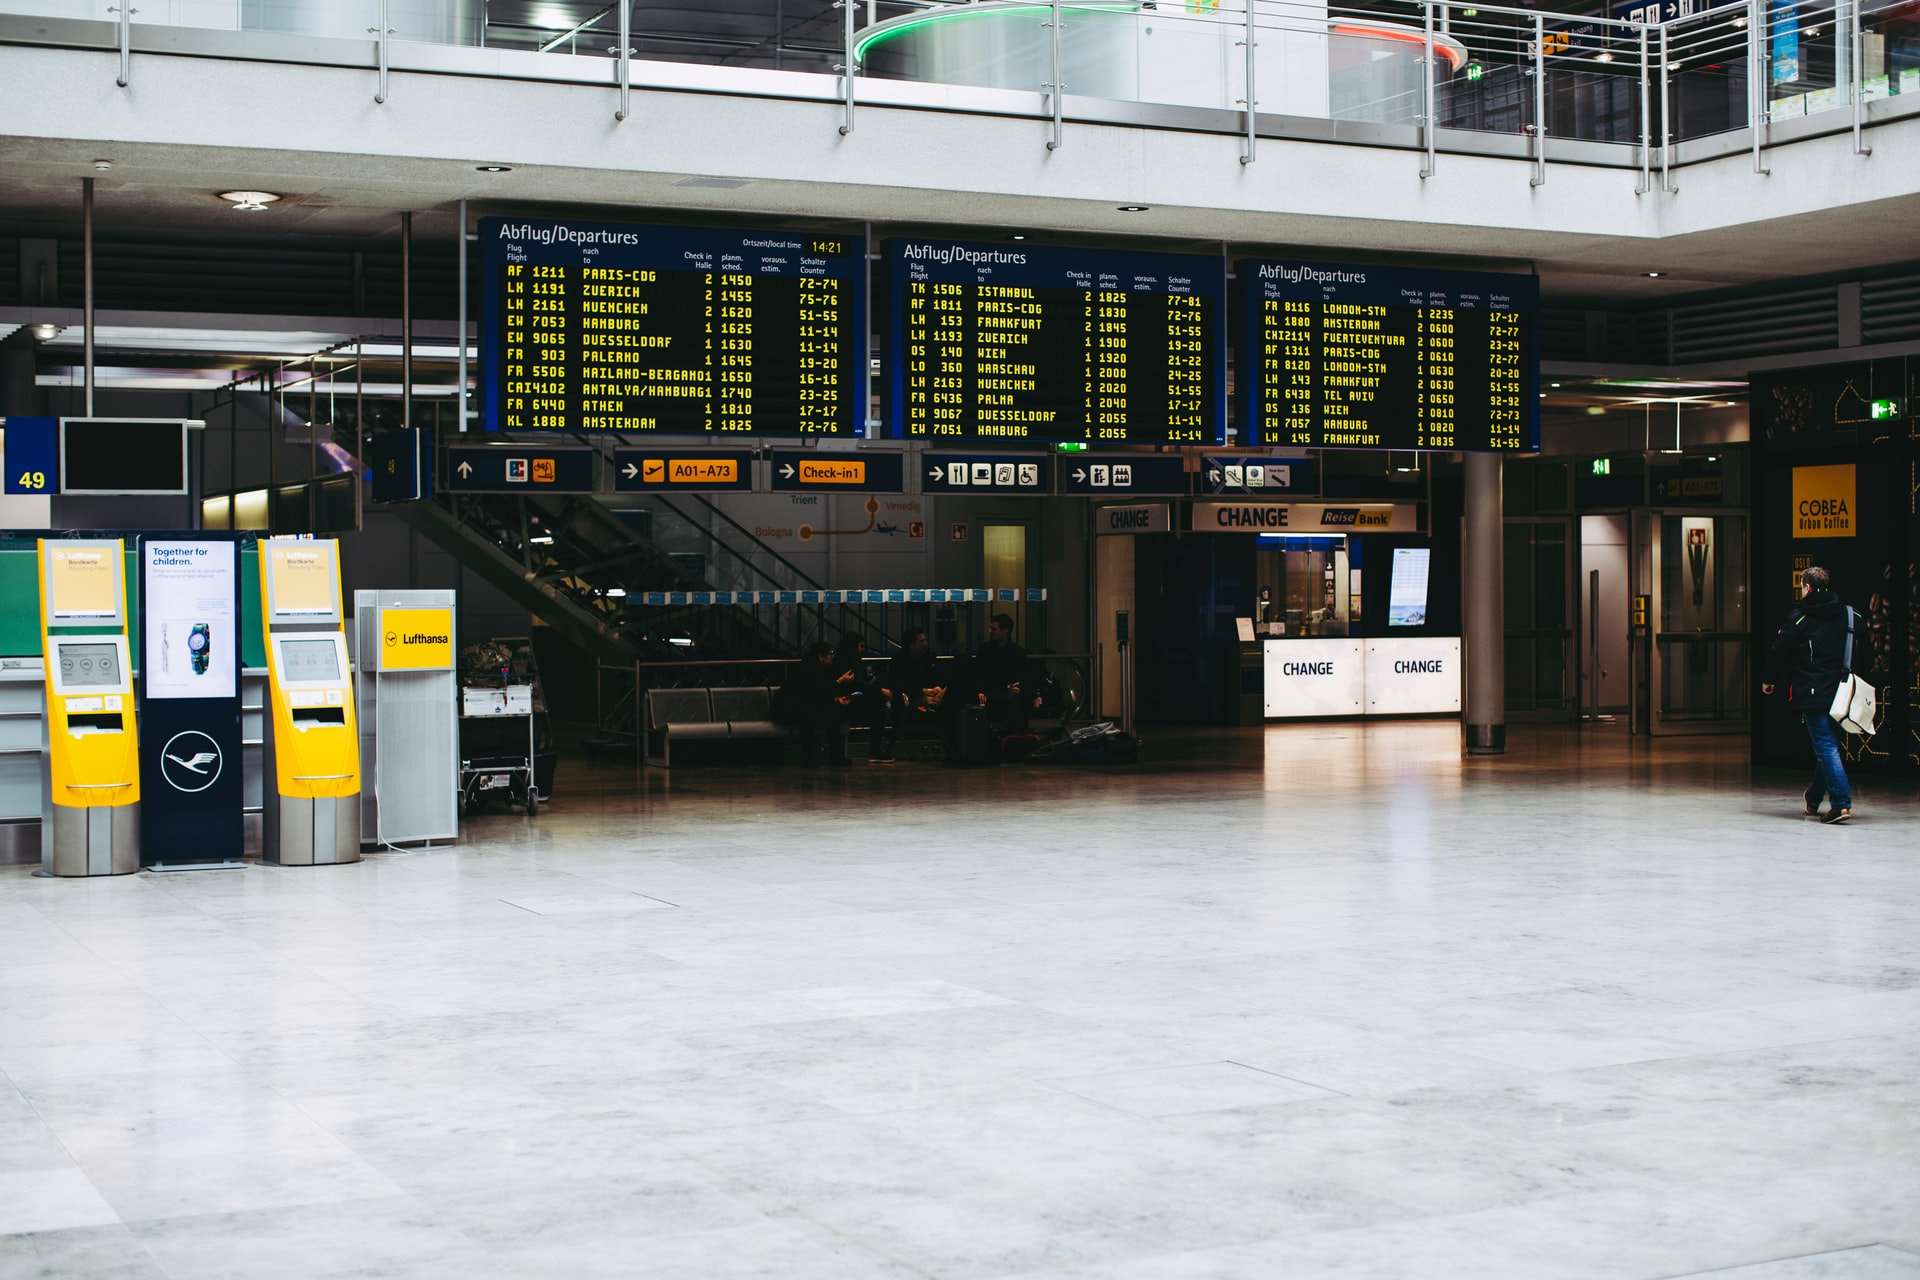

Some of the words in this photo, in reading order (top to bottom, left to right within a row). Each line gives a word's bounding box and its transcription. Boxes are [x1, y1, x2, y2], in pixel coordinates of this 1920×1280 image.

[500, 224, 638, 246] Abflug/Departures
[507, 244, 522, 252] Flug
[743, 239, 786, 248] Ortszeit/local
[787, 240, 802, 248] time
[812, 241, 841, 253] 14:21
[507, 253, 527, 262] Flight
[684, 252, 704, 260] Check
[722, 254, 744, 262] planm.
[800, 258, 826, 266] Schalter
[904, 244, 1026, 266] Abflug/Departures
[696, 262, 712, 270] Halle
[800, 266, 825, 274] Counter
[507, 265, 522, 276] AF
[533, 266, 565, 279] 1211
[582, 268, 656, 282] PARIS-CDG
[721, 274, 752, 286] 1450
[800, 278, 837, 289] 72-74
[1258, 264, 1366, 284] Abflug/Departures
[533, 283, 565, 295] 1191
[583, 284, 640, 297] ZUERICH
[721, 290, 752, 302] 1455
[800, 293, 838, 305] 75-76
[933, 284, 962, 295] 1506
[978, 286, 1034, 299] ISTANBUL
[1099, 292, 1126, 302] 1825
[507, 298, 524, 310] LH
[533, 299, 565, 312] 2161
[582, 301, 648, 314] MUENCHEN
[721, 307, 752, 318] 1620
[799, 309, 838, 321] 51-55
[933, 299, 961, 311] 1811
[977, 301, 1042, 315] PARIS-CDG
[1099, 307, 1126, 318] 1830
[1284, 302, 1310, 313] 8116
[1430, 309, 1453, 320] 2235
[507, 315, 523, 327] EW
[533, 315, 565, 328] 7053
[583, 317, 640, 331] HAMBURG
[721, 323, 752, 334] 1625
[800, 325, 838, 337] 11-14
[941, 315, 963, 326] 153
[977, 316, 1041, 330] FRANKFURT
[1099, 322, 1126, 333] 1845
[1285, 316, 1310, 327] 1880
[1430, 323, 1453, 334] 0600
[507, 331, 523, 343] EW
[533, 332, 565, 345] 9065
[583, 334, 671, 348] DUESSELDORF
[721, 339, 752, 351] 1630
[800, 341, 837, 353] 11-14
[933, 330, 963, 341] 1193
[978, 332, 1028, 344] ZUERICH
[1099, 337, 1127, 348] 1900
[1430, 337, 1454, 348] 0600
[507, 348, 523, 360] FR
[541, 349, 566, 361] 903
[583, 351, 640, 363] PALERMO
[721, 355, 752, 366] 1645
[800, 357, 837, 369] 19-20
[941, 346, 963, 357] 140
[977, 347, 1006, 359] WIEN
[1099, 352, 1126, 364] 1920
[1285, 345, 1310, 356] 1311
[1430, 351, 1454, 362] 0610
[507, 364, 523, 377] FR
[532, 365, 565, 378] 5506
[721, 371, 752, 383] 1650
[800, 373, 837, 385] 16-16
[942, 362, 963, 373] 360
[977, 363, 1035, 375] WARSCHAU
[1099, 367, 1126, 379] 2000
[1285, 359, 1311, 371] 8120
[1430, 365, 1454, 376] 0630
[933, 377, 963, 388] 2163
[977, 378, 1035, 390] MUENCHEN
[1099, 383, 1127, 393] 2020
[1292, 375, 1310, 385] 143
[1430, 379, 1454, 390] 0630
[721, 387, 752, 399] 1740
[800, 389, 837, 401] 23-25
[933, 393, 963, 404] 6436
[977, 394, 1014, 405] PALMA
[1099, 397, 1126, 408] 2040
[1285, 389, 1311, 399] 6438
[1324, 390, 1342, 401] TEL
[1350, 391, 1374, 402] AVIV
[1430, 394, 1454, 404] 0650
[507, 398, 523, 410] FR
[532, 399, 566, 411] 6440
[583, 400, 623, 412] ATHEN
[721, 403, 752, 415] 1810
[800, 405, 837, 416] 17-17
[1292, 404, 1310, 414] 136
[1430, 408, 1454, 419] 0810
[507, 415, 522, 427] KL
[533, 415, 565, 427] 1888
[721, 419, 752, 431] 1825
[800, 421, 837, 432] 72-76
[933, 408, 962, 419] 9067
[977, 409, 1056, 421] DUESSELDORF
[1099, 413, 1127, 424] 2055
[934, 424, 961, 435] 7051
[977, 425, 1028, 436] HAMBURG
[1099, 428, 1126, 438] 2055
[1285, 418, 1310, 428] 7057
[1430, 422, 1454, 432] 0820
[1292, 433, 1310, 443] 145
[1430, 436, 1454, 446] 0835
[675, 464, 730, 476] A01-A73
[18, 471, 46, 489] 49
[792, 495, 817, 504] Trient
[1799, 498, 1848, 516] COBEA
[1110, 510, 1149, 528] CHANGE
[1217, 508, 1288, 526] CHANGE
[1324, 512, 1354, 522] Reise
[1359, 514, 1387, 524] Bank
[1799, 518, 1821, 530] Urban
[1824, 516, 1849, 529] Coffee
[754, 527, 792, 538] Bologna
[152, 548, 193, 557] Together
[196, 548, 208, 556] for
[152, 558, 192, 566] children.
[403, 634, 448, 644] Lufthansa
[1283, 662, 1334, 676] CHANGE
[1394, 660, 1442, 674] CHANGE
